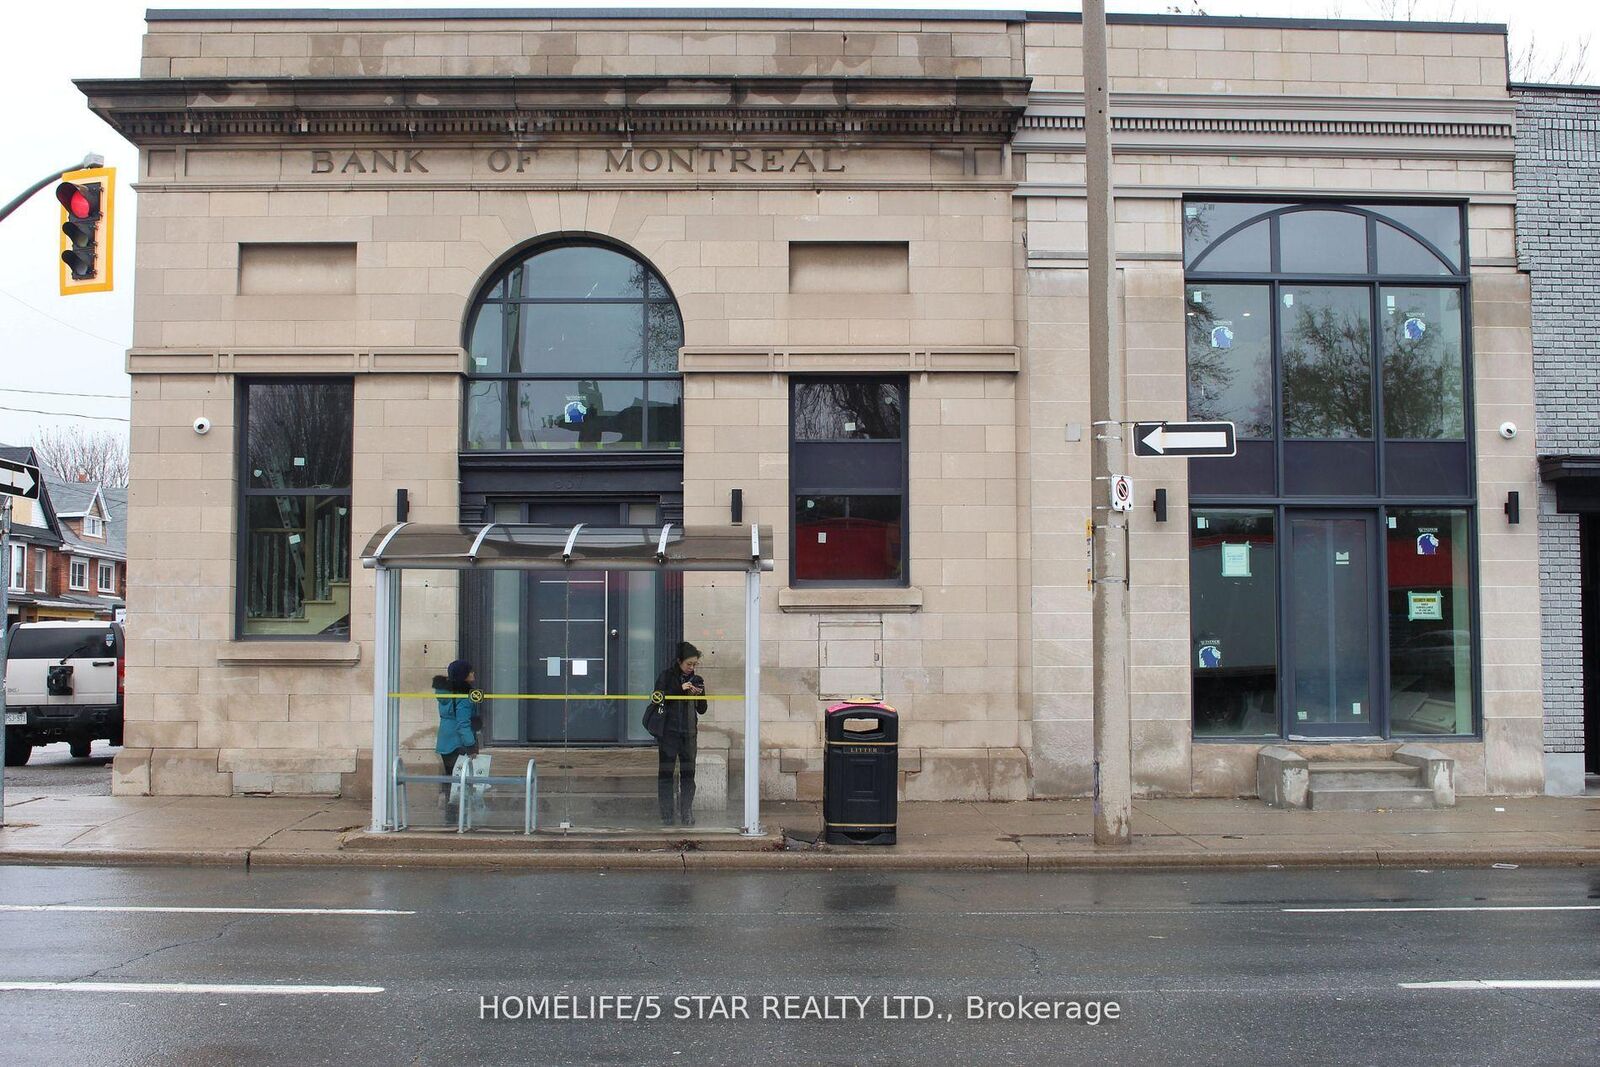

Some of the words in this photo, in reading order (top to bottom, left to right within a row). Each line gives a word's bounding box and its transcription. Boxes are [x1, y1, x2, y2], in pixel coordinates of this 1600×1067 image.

[310, 149, 430, 174] BANK
[487, 149, 540, 173] OF
[604, 148, 847, 173] MONTREAL
